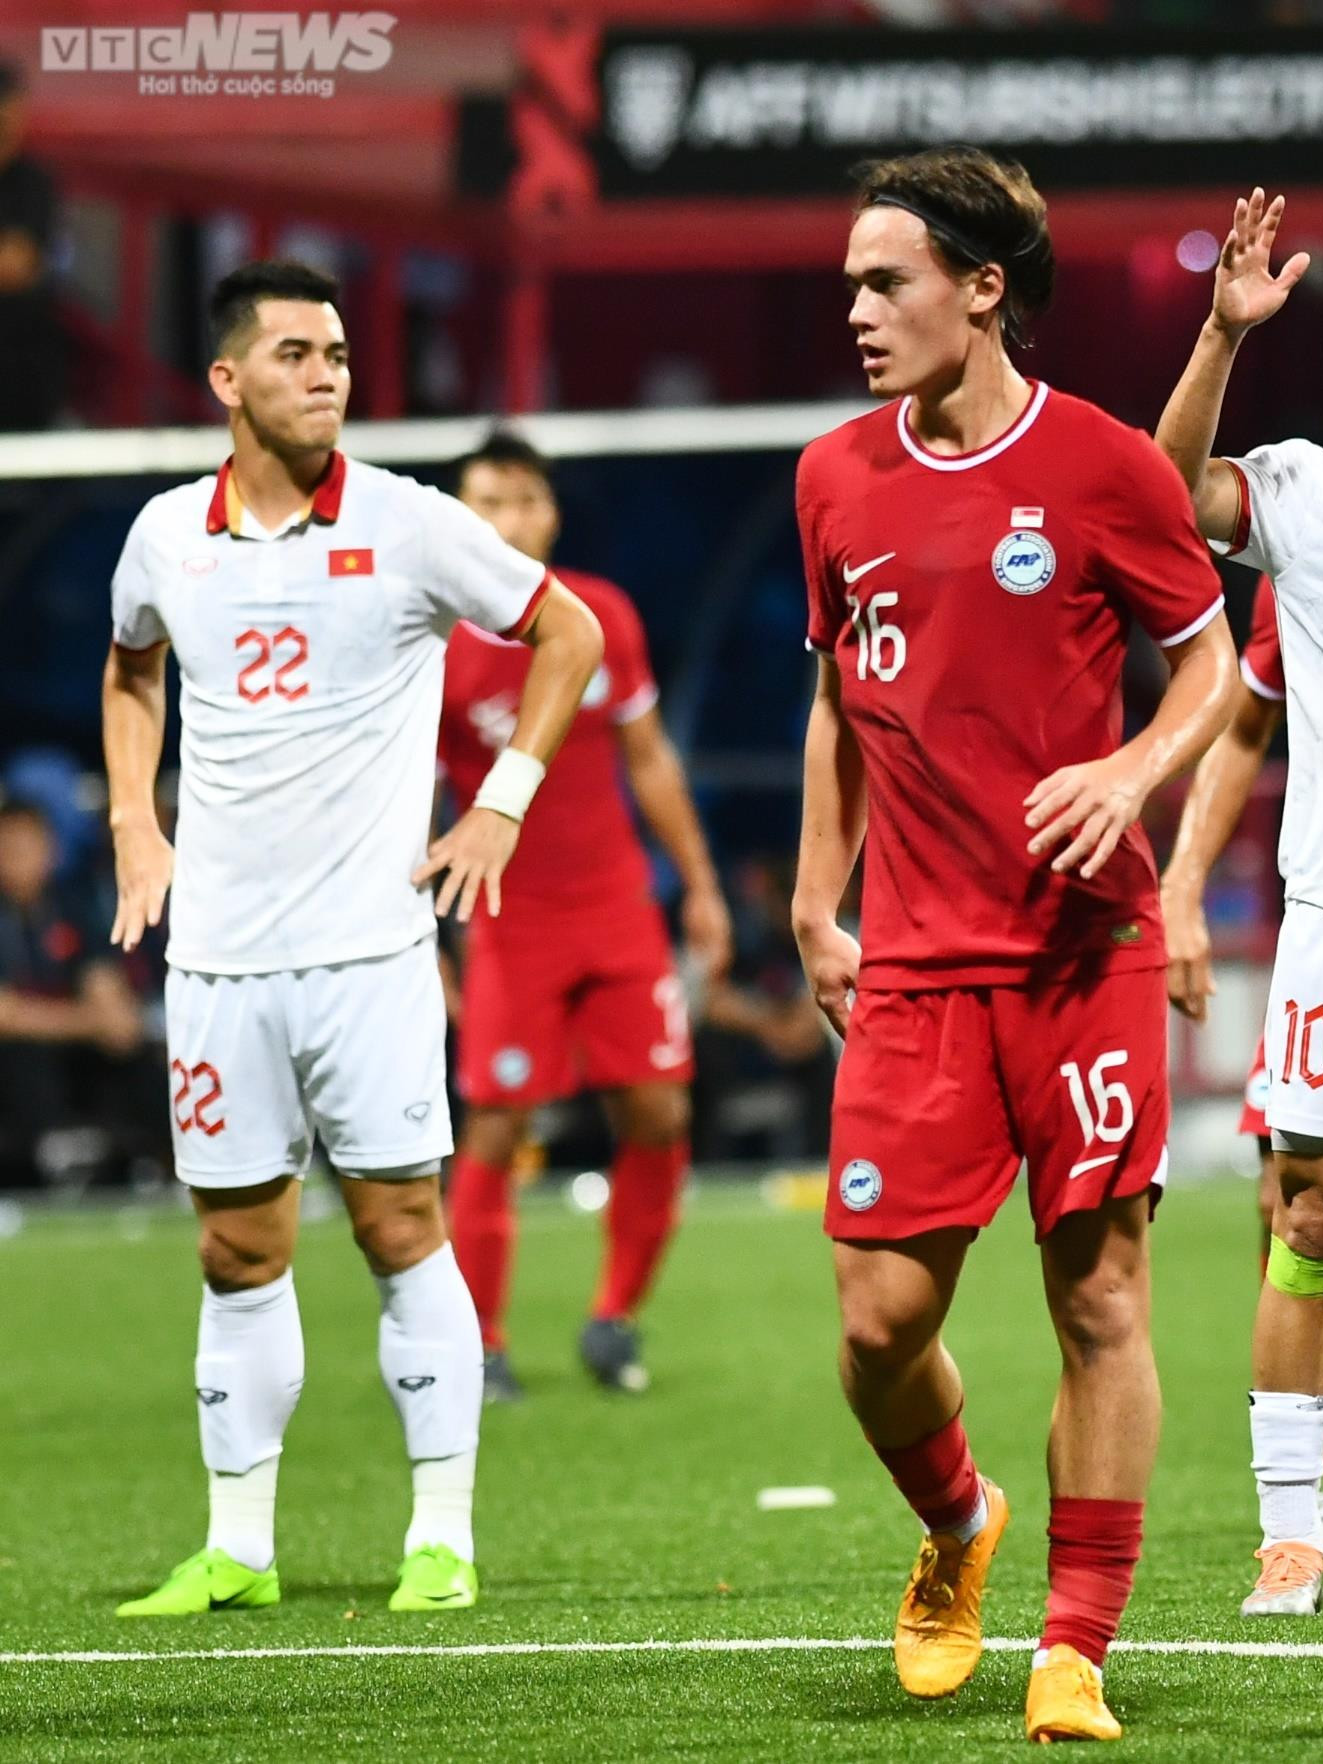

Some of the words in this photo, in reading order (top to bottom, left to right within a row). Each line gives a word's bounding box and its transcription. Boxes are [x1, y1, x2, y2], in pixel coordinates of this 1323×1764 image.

[694, 66, 818, 143] AFF
[235, 625, 309, 704] 22
[846, 591, 907, 682] 16
[171, 1058, 225, 1136] 22
[1059, 1049, 1134, 1148] 16
